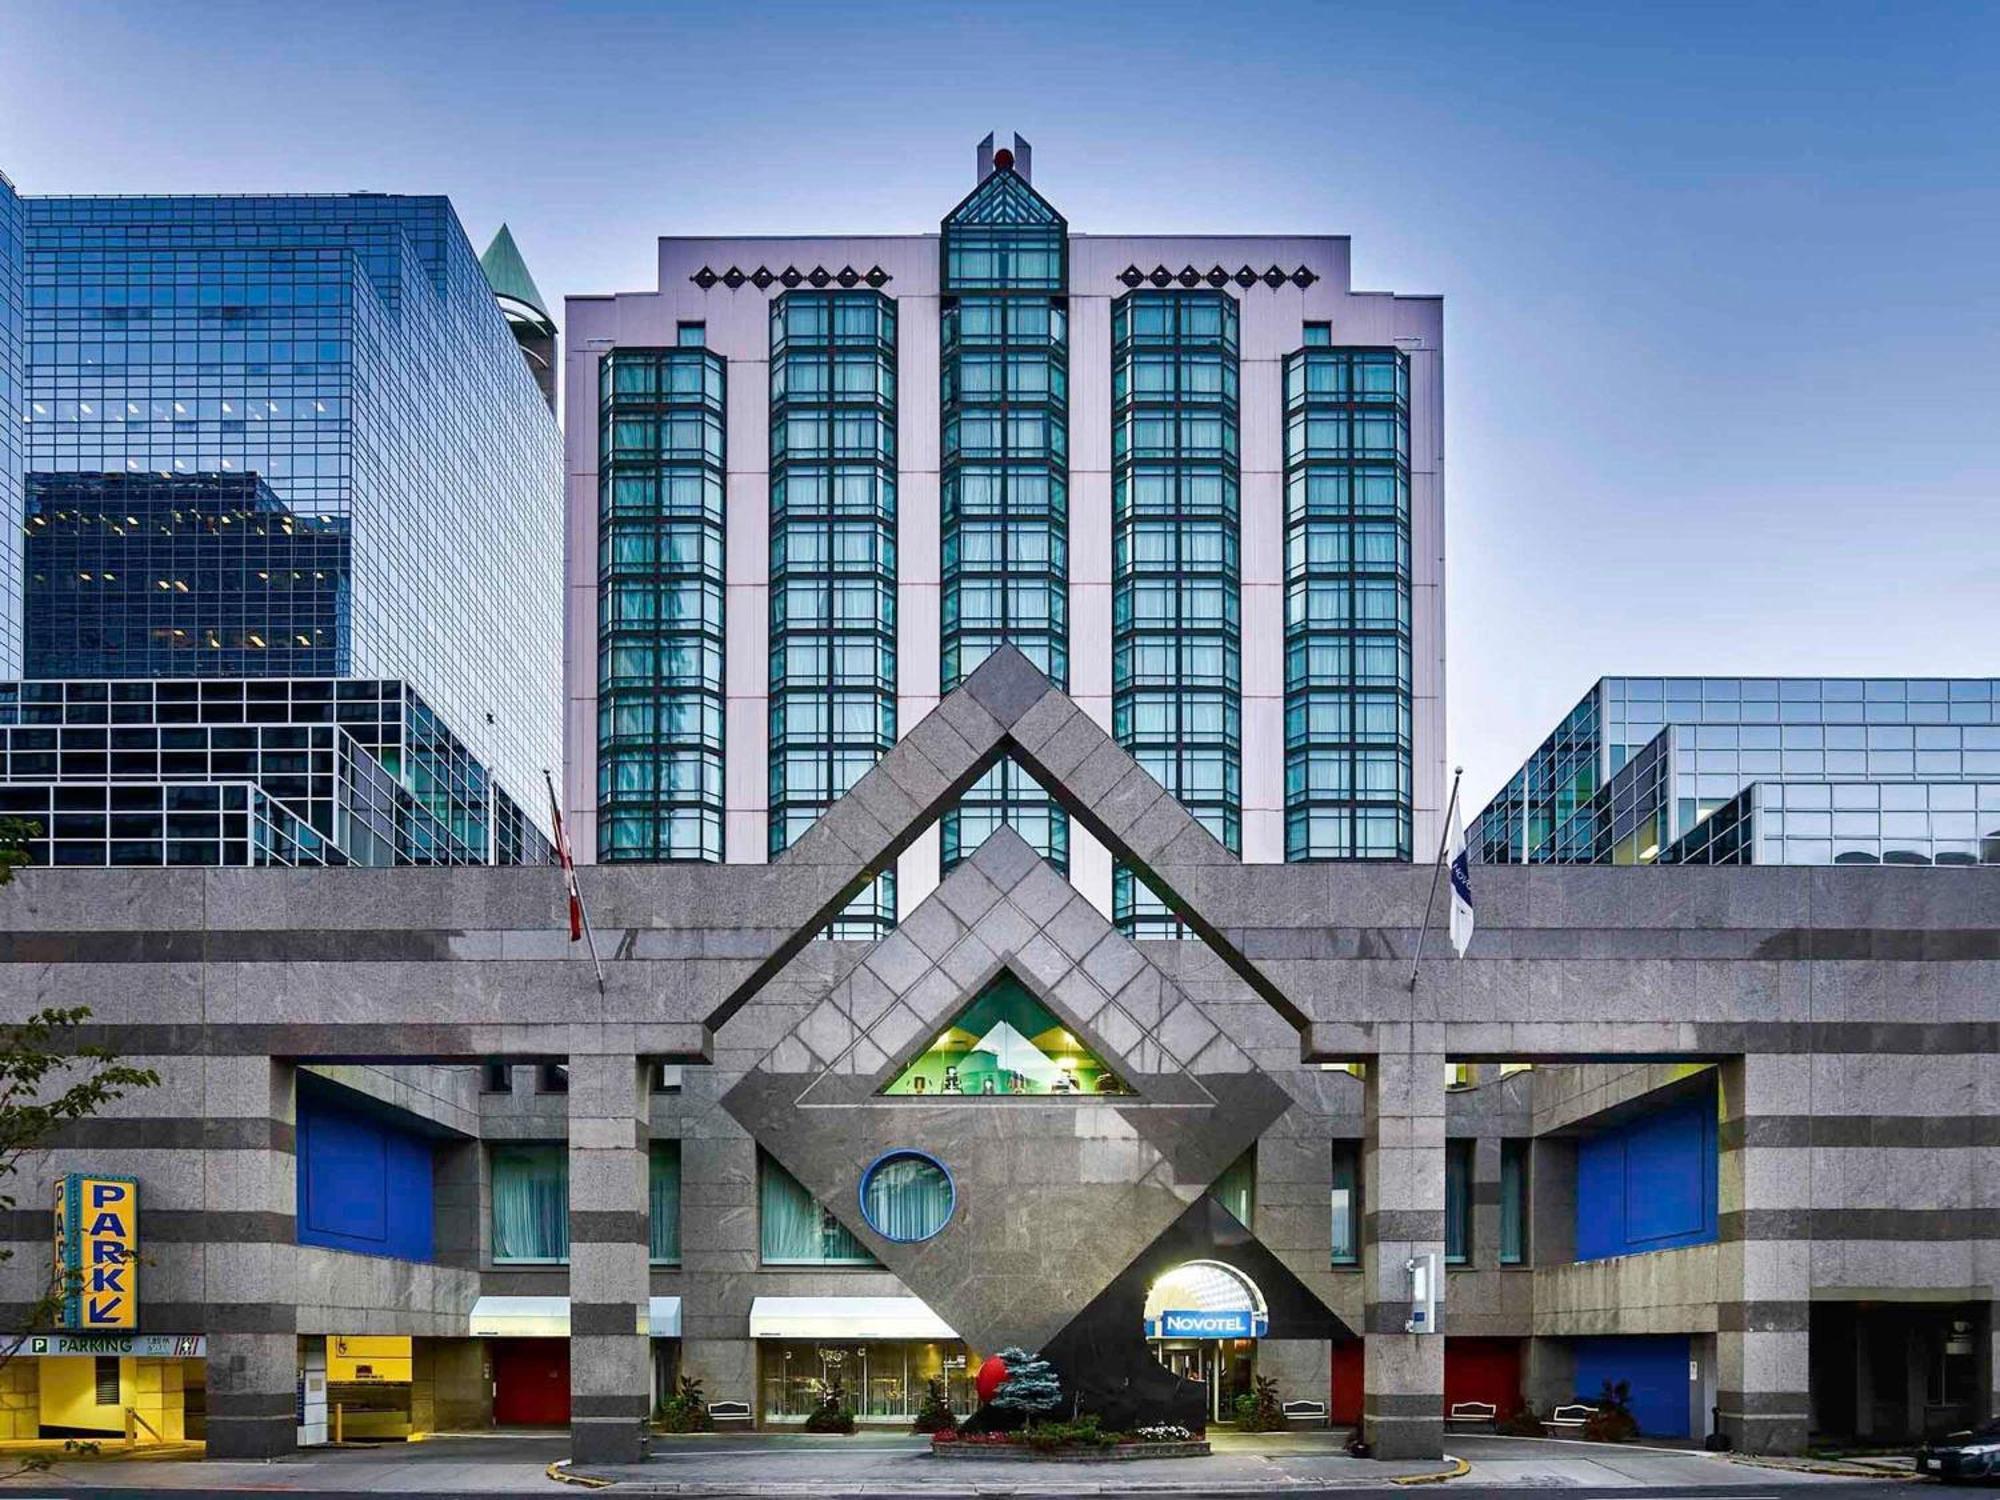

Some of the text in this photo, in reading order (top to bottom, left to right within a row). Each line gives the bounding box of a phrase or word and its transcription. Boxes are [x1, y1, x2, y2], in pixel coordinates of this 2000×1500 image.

[90, 1185, 126, 1292] PARK
[1167, 1316, 1246, 1331] NOVOTEL
[35, 1340, 45, 1352] P
[59, 1338, 133, 1353] PARKING
